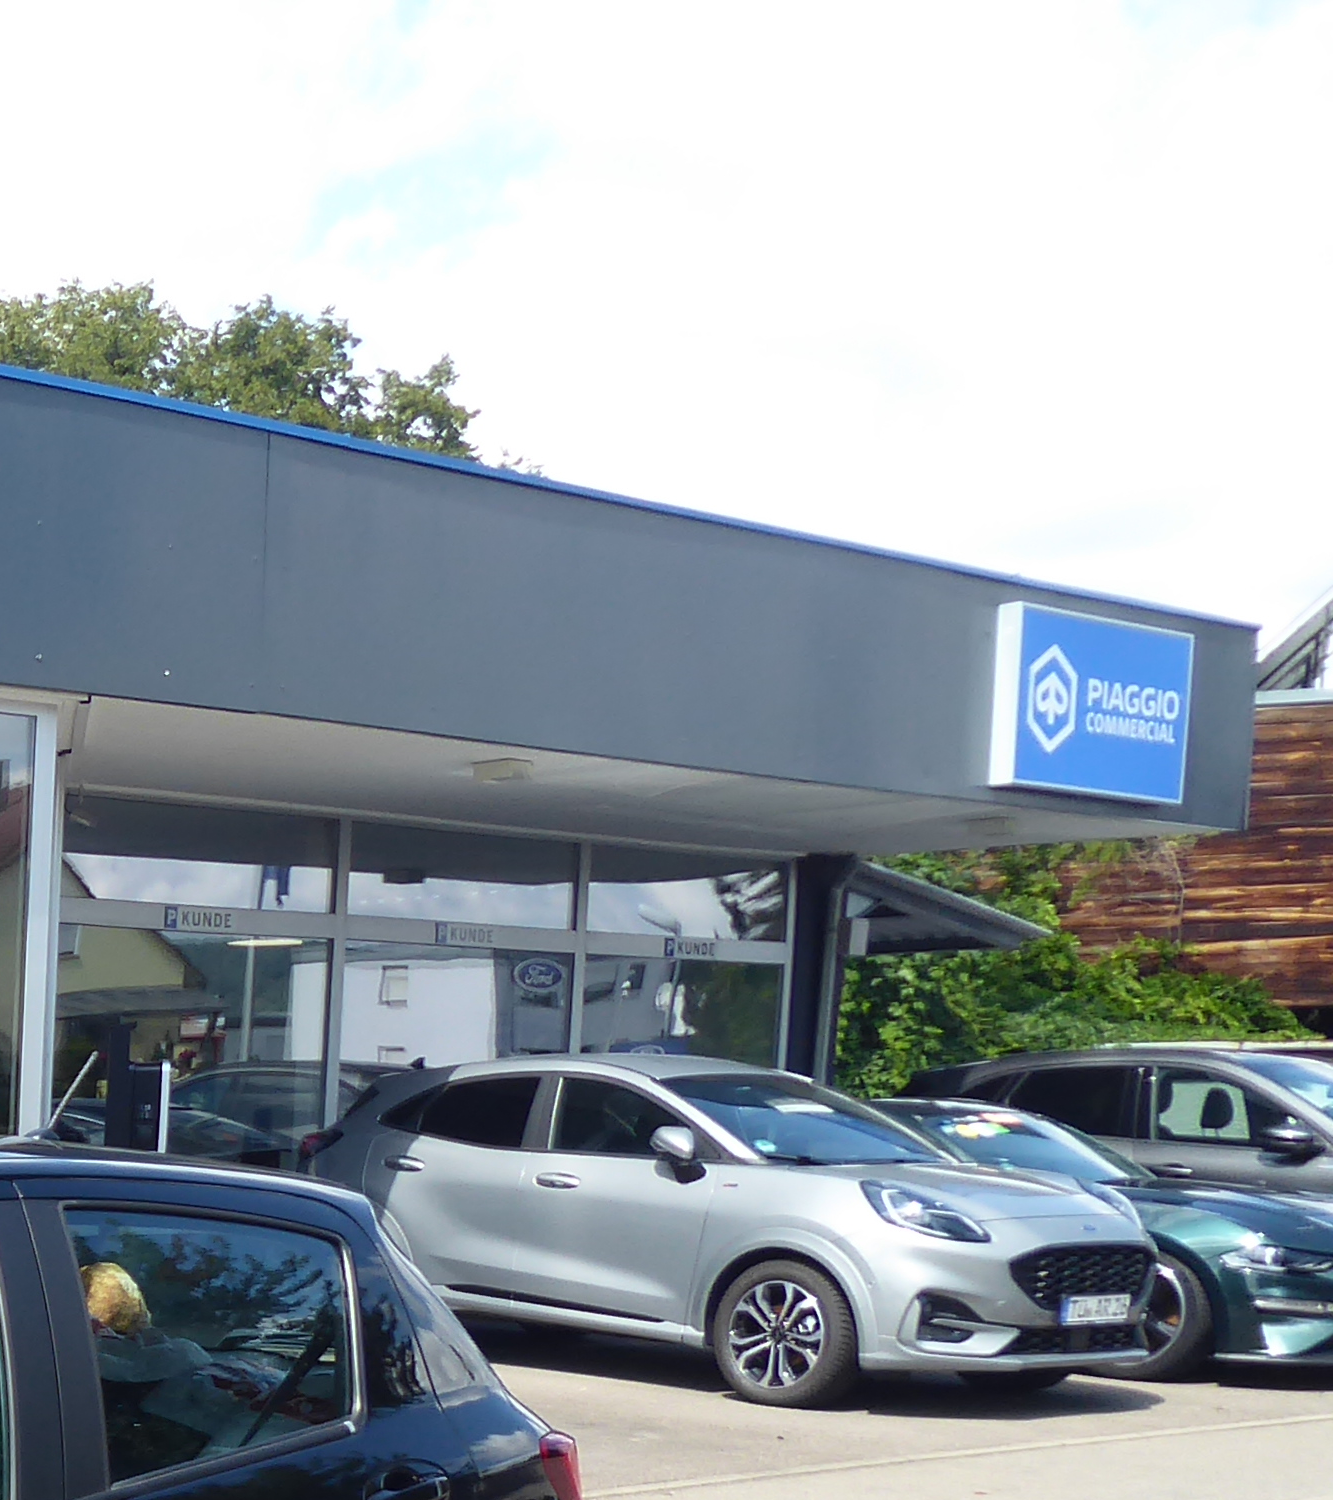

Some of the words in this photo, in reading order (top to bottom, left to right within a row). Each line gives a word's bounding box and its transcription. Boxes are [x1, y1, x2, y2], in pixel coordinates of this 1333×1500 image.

[1086, 677, 1180, 721] PIAGGIO
[1085, 711, 1176, 744] COMMERCIAL
[182, 910, 232, 928] KUNDE
[450, 926, 494, 943] KUNDE
[677, 940, 715, 957] KUNDE
